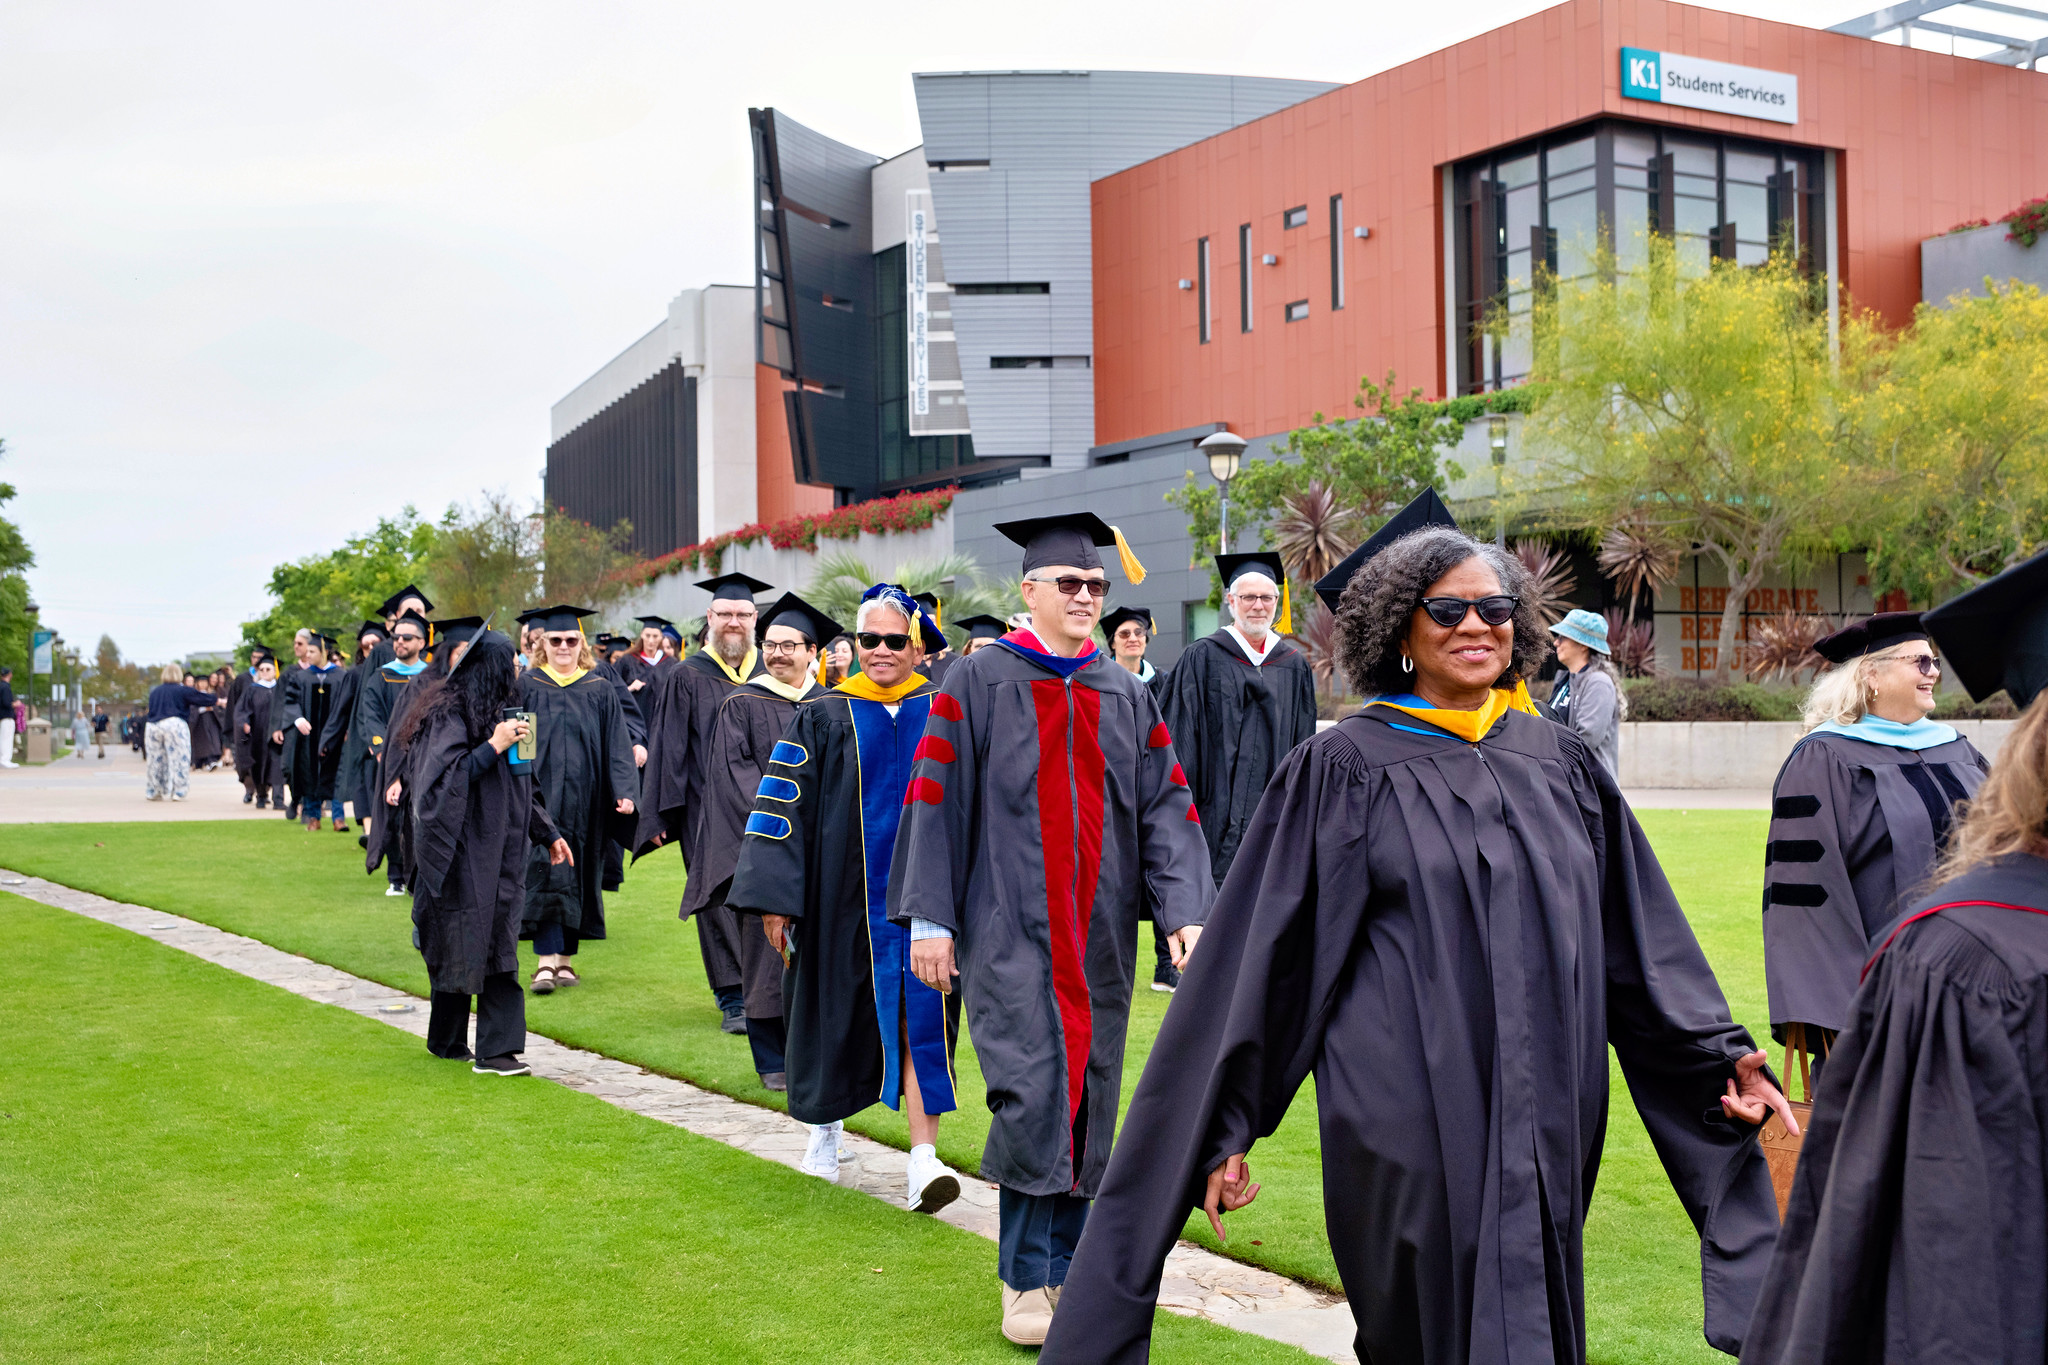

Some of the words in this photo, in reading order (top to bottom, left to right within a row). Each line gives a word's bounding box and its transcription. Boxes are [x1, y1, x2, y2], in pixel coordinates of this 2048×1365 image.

[1630, 58, 1659, 90] K1
[1667, 71, 1724, 96] Student
[1728, 81, 1786, 106] Services
[915, 214, 924, 301] STUDENT
[916, 312, 926, 411] SERVICES
[1680, 586, 1824, 612] REHDRATE.
